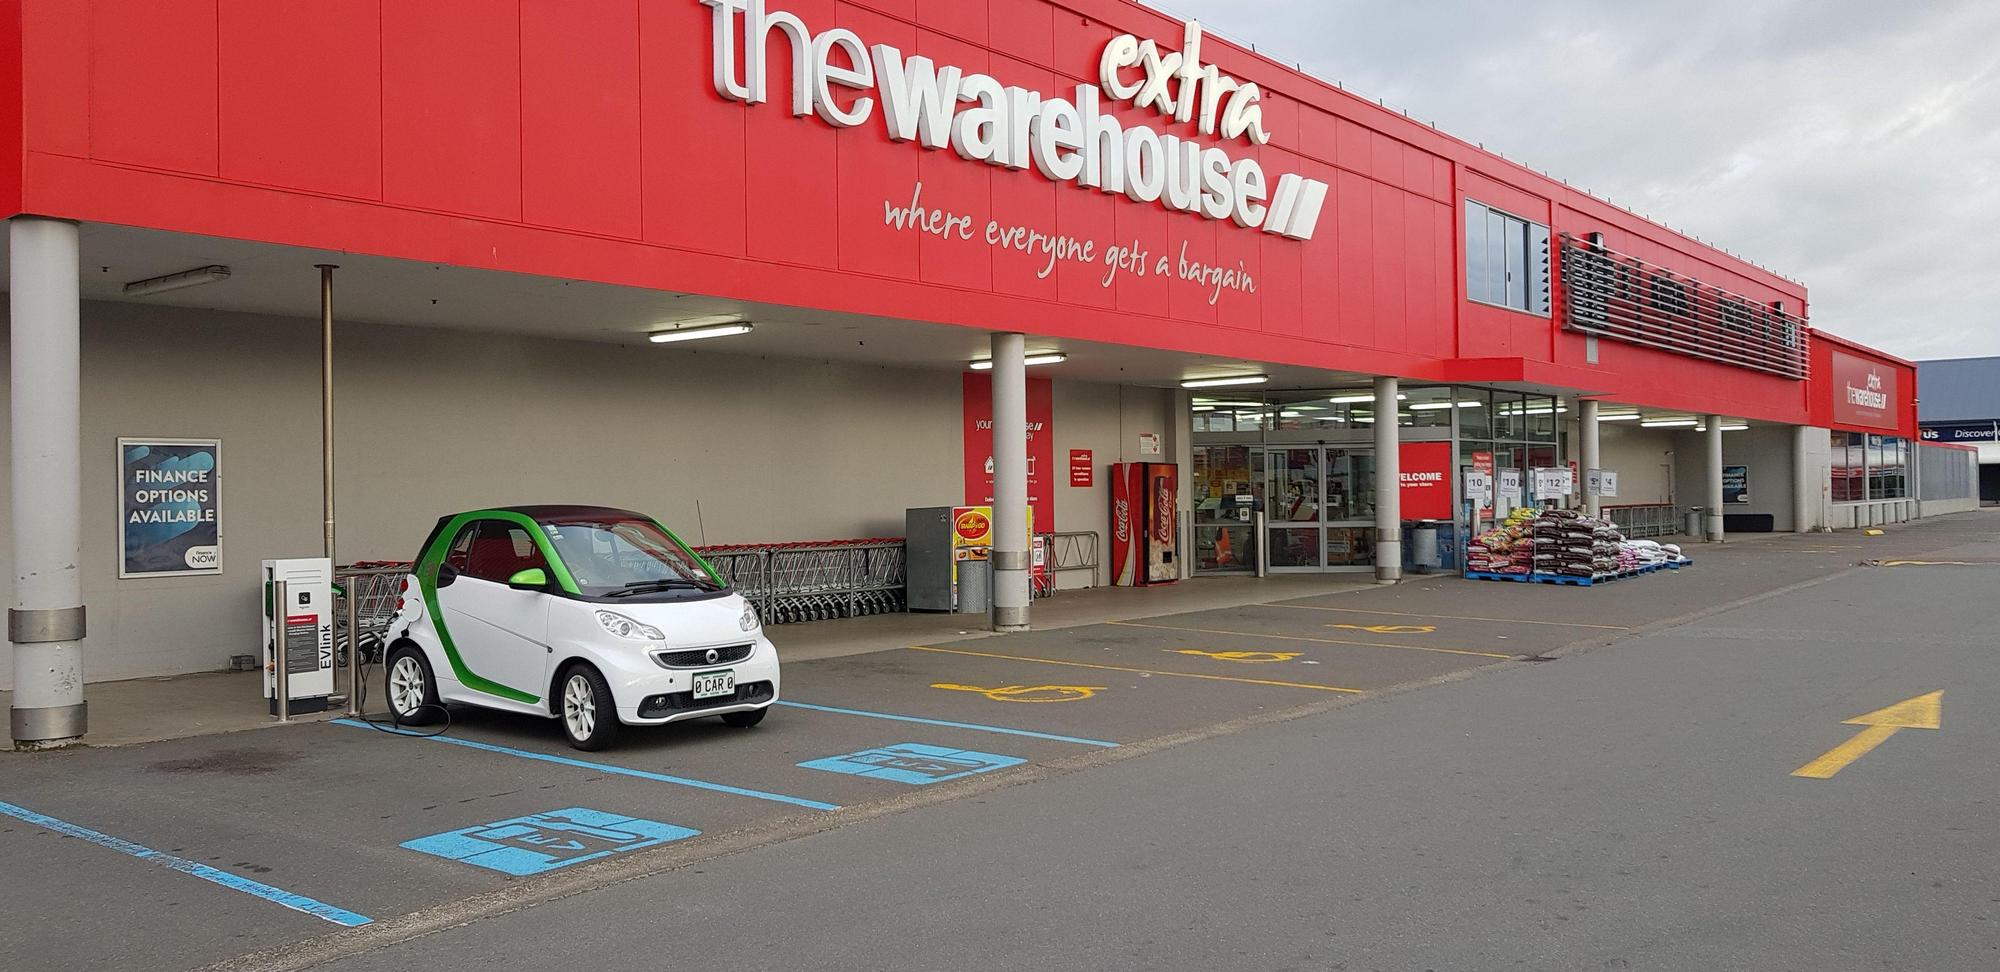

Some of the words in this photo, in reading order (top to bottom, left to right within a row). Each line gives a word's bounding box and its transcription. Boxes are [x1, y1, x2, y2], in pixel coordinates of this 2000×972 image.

[1100, 21, 1271, 144] extra
[884, 181, 976, 240] where
[985, 220, 1097, 279] everyone
[1101, 239, 1148, 288] gets
[1155, 255, 1171, 277] a
[1178, 239, 1256, 305] bargain
[135, 470, 208, 483] FINANCE
[1399, 472, 1442, 481] ELCOME
[135, 490, 208, 503] OPTIONS
[129, 509, 214, 523] AVAILABLE
[192, 555, 216, 563] NOW
[320, 624, 331, 669] EVlink
[705, 678, 724, 692] CAR
